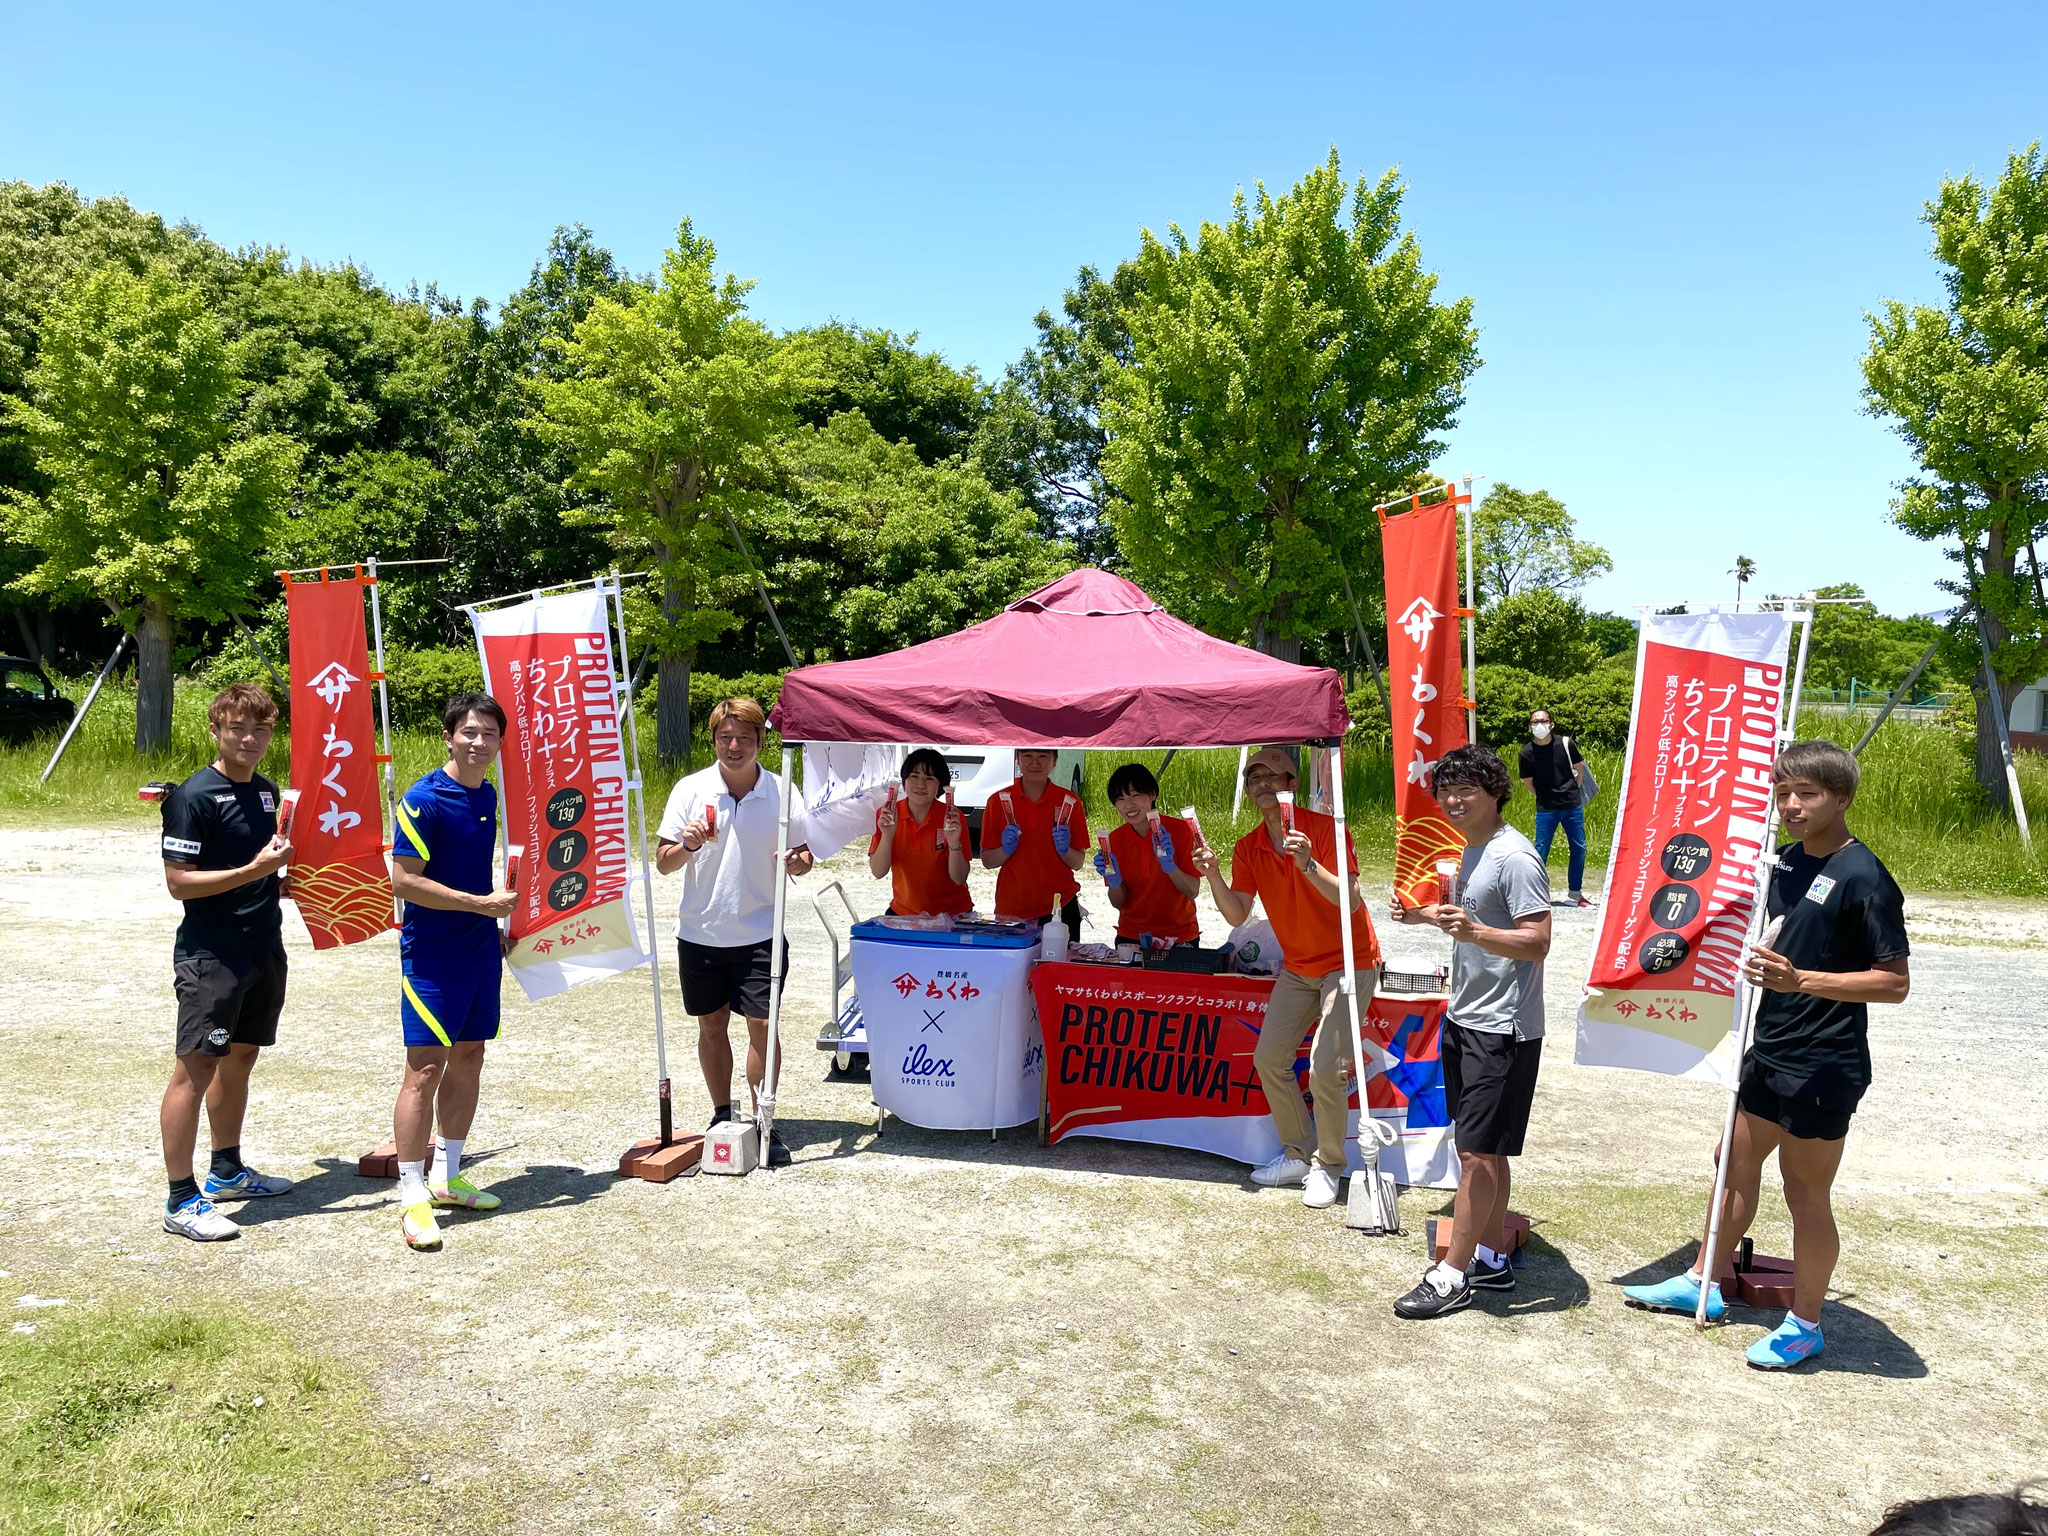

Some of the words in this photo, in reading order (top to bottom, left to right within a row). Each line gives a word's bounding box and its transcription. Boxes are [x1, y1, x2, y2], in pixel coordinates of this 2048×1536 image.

[573, 633, 621, 762] PROTEIN
[548, 654, 584, 782] プロテイン
[1730, 661, 1783, 824] PROTEIN
[1694, 683, 1737, 828] プロテイン
[318, 722, 362, 838] ちくわ
[549, 794, 584, 812] タンパク質
[558, 807, 576, 822] 13g
[1666, 845, 1710, 858] タンパク質
[1672, 855, 1697, 874] 13g
[1691, 835, 1763, 998] CHIKUWA
[559, 923, 602, 947] ちくわ
[1657, 937, 1677, 949] 必須
[925, 979, 980, 1001] ちくわ
[1645, 1003, 1698, 1023] ちくわ
[1058, 1002, 1222, 1056] PROTEIN
[902, 1043, 956, 1077] ilex
[901, 1077, 931, 1086] SPORTS
[935, 1078, 956, 1088] CLUB
